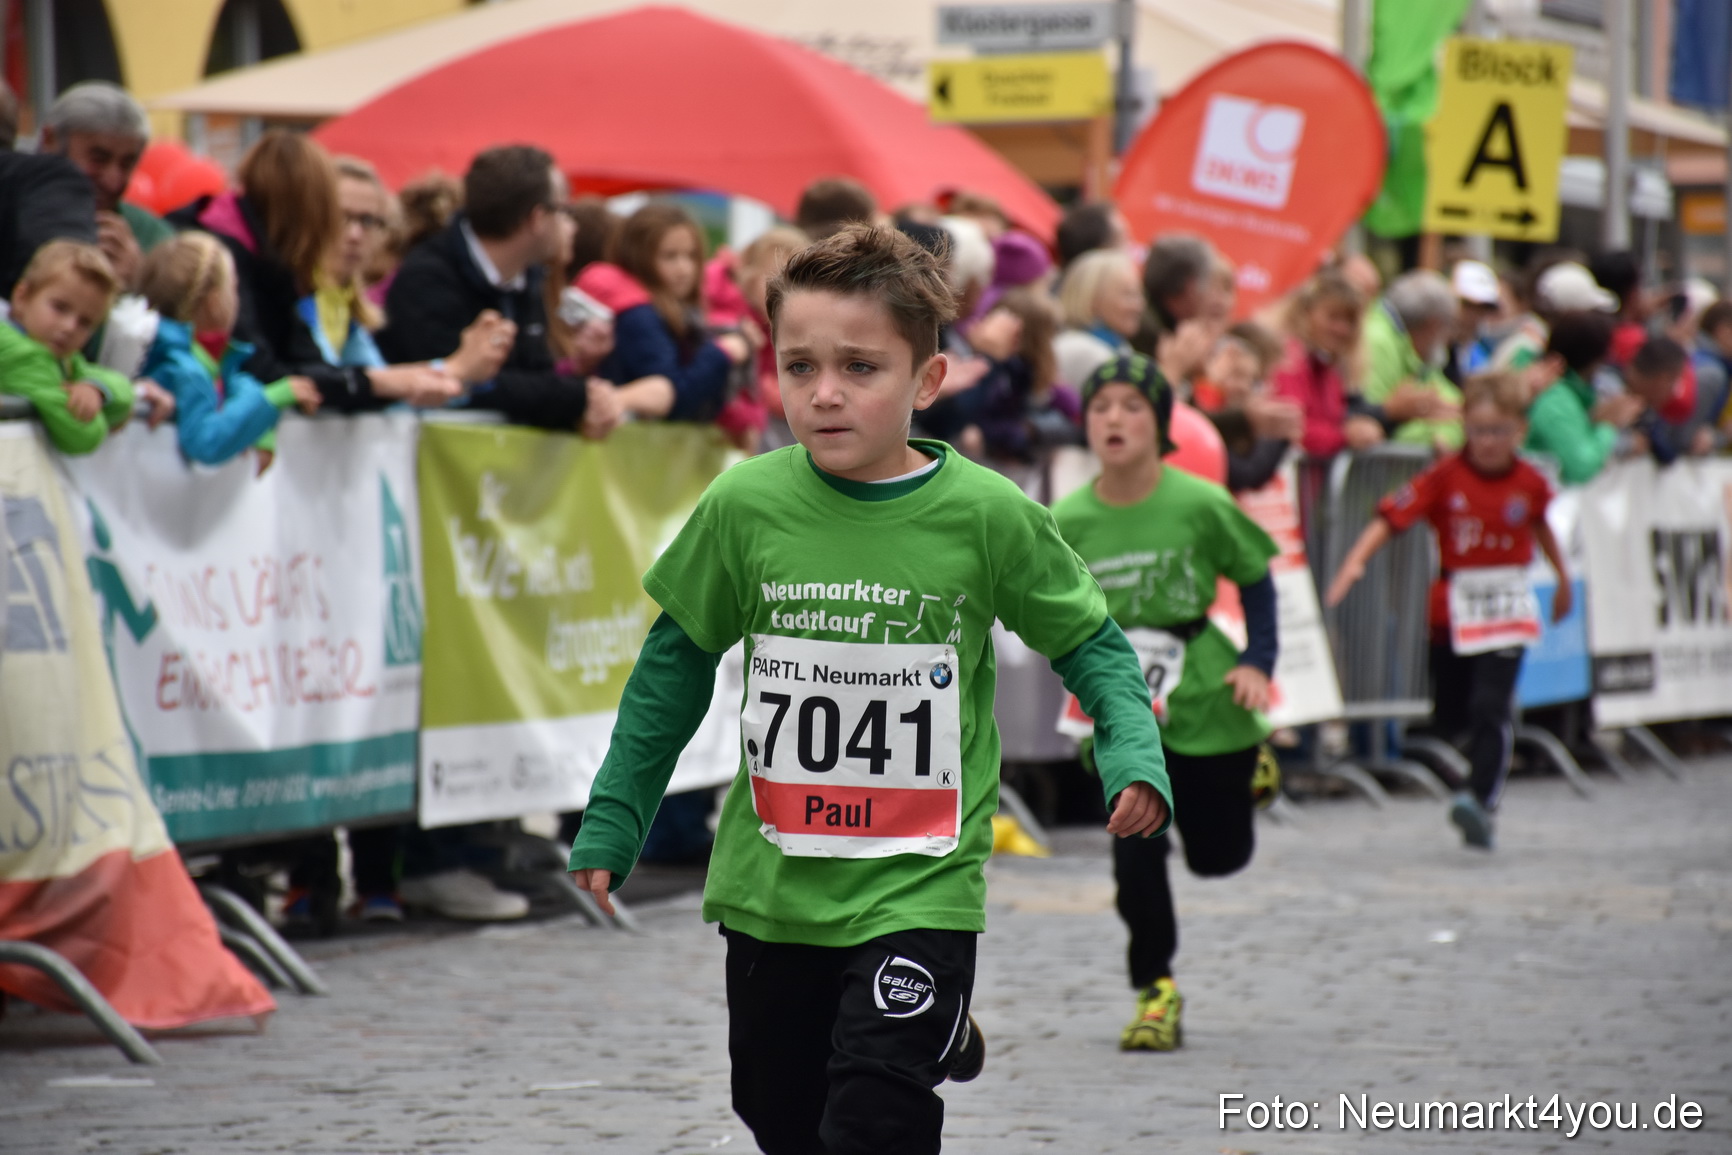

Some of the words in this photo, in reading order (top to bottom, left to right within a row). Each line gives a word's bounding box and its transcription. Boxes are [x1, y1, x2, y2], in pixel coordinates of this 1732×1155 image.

[1459, 46, 1557, 85] Block
[1461, 102, 1528, 191] A
[761, 579, 910, 606] Neumarkter
[771, 610, 876, 639] tadtlauf
[753, 657, 806, 681] PARTL
[813, 664, 922, 687] Neumarkt
[760, 691, 931, 776] 7041
[805, 795, 872, 828] Paul
[881, 975, 932, 992] saller
